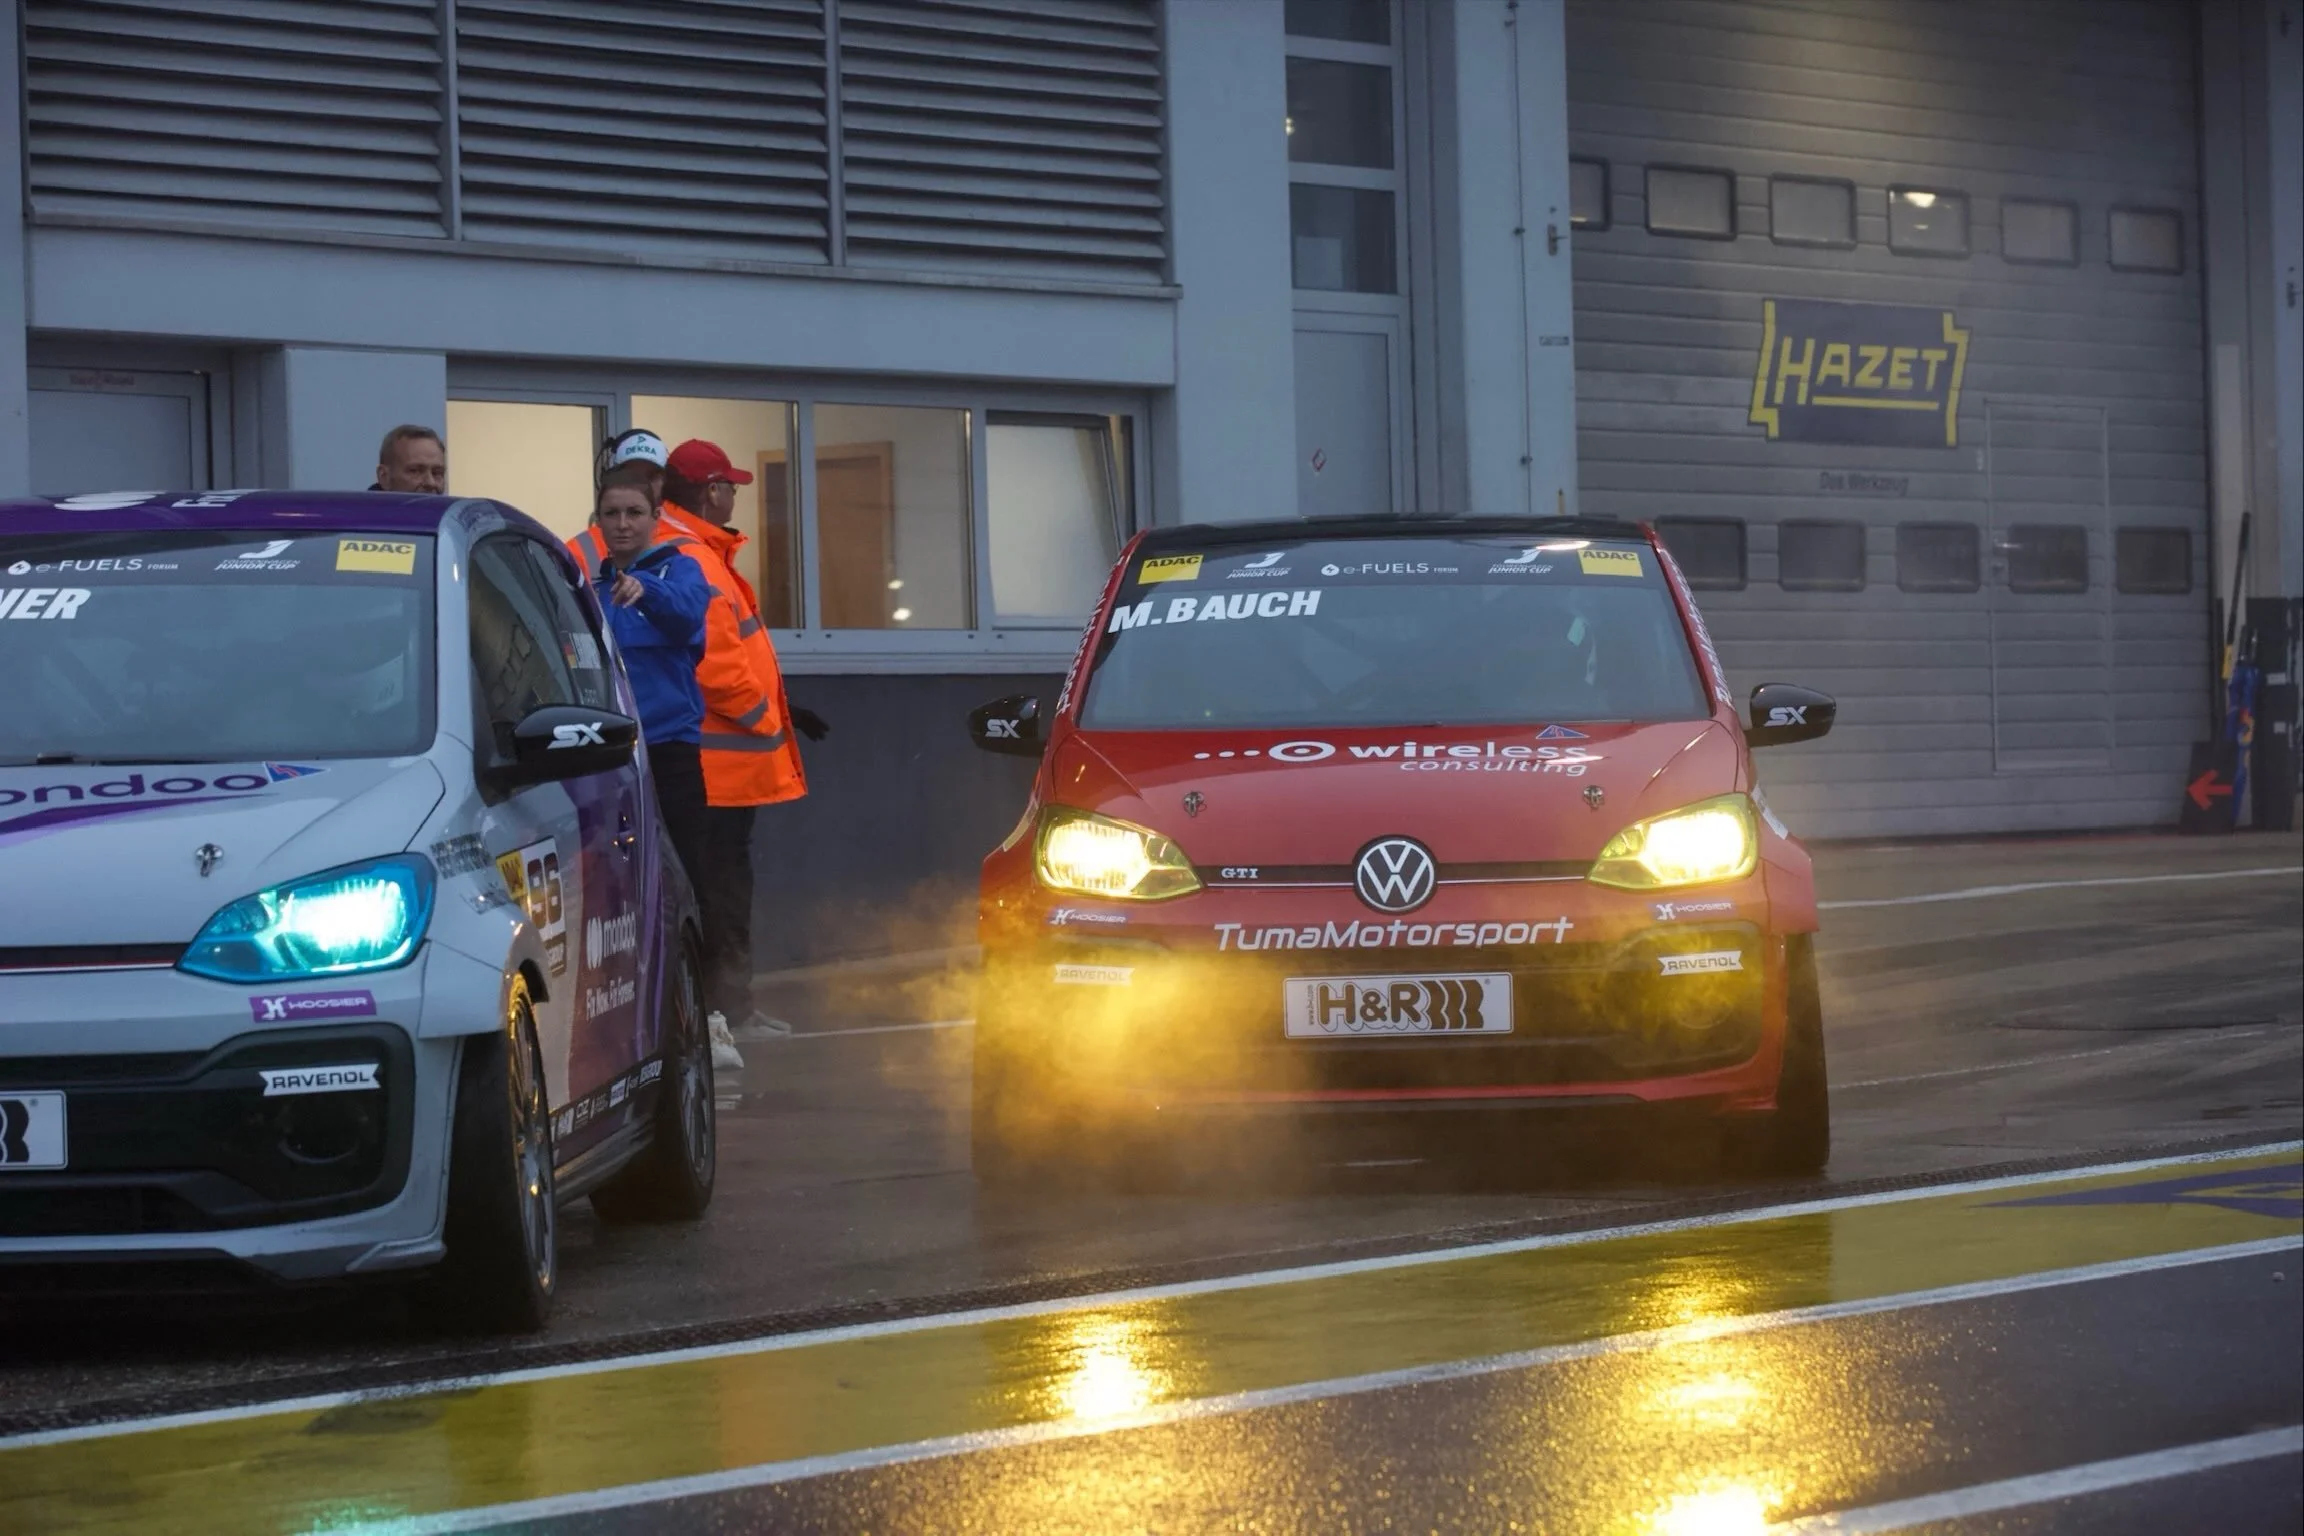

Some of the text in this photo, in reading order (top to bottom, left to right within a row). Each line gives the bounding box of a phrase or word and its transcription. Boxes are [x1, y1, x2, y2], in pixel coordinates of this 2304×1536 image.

[1774, 336, 1948, 404] HAZET
[625, 446, 656, 456] DEKRA
[343, 542, 412, 555] ADAC
[1146, 556, 1200, 569] ADAC
[1582, 551, 1636, 561] ADAC
[35, 558, 143, 573] e-FUELS
[213, 563, 265, 571] JUNIOR
[1343, 562, 1430, 575] e-FUELS
[1226, 569, 1290, 579] JUNIOR CUP
[1108, 590, 1322, 633] M.BAUCH
[1764, 706, 1808, 727] SX
[985, 718, 1021, 738] SX
[547, 722, 606, 749] SX
[1349, 741, 1589, 759] wireless
[1400, 759, 1589, 777] consulting
[1221, 868, 1258, 879] GTI
[1676, 902, 1732, 913] HOOSIER
[1069, 913, 1126, 923] HOOSIER
[1214, 916, 1574, 951] TumaMotorsport
[1668, 957, 1737, 970] RAVENOL
[1060, 968, 1126, 981] RAVENOL
[288, 997, 368, 1010] HOOSIER
[1318, 982, 1422, 1028] H&R
[272, 1071, 371, 1089] RAVENOL
